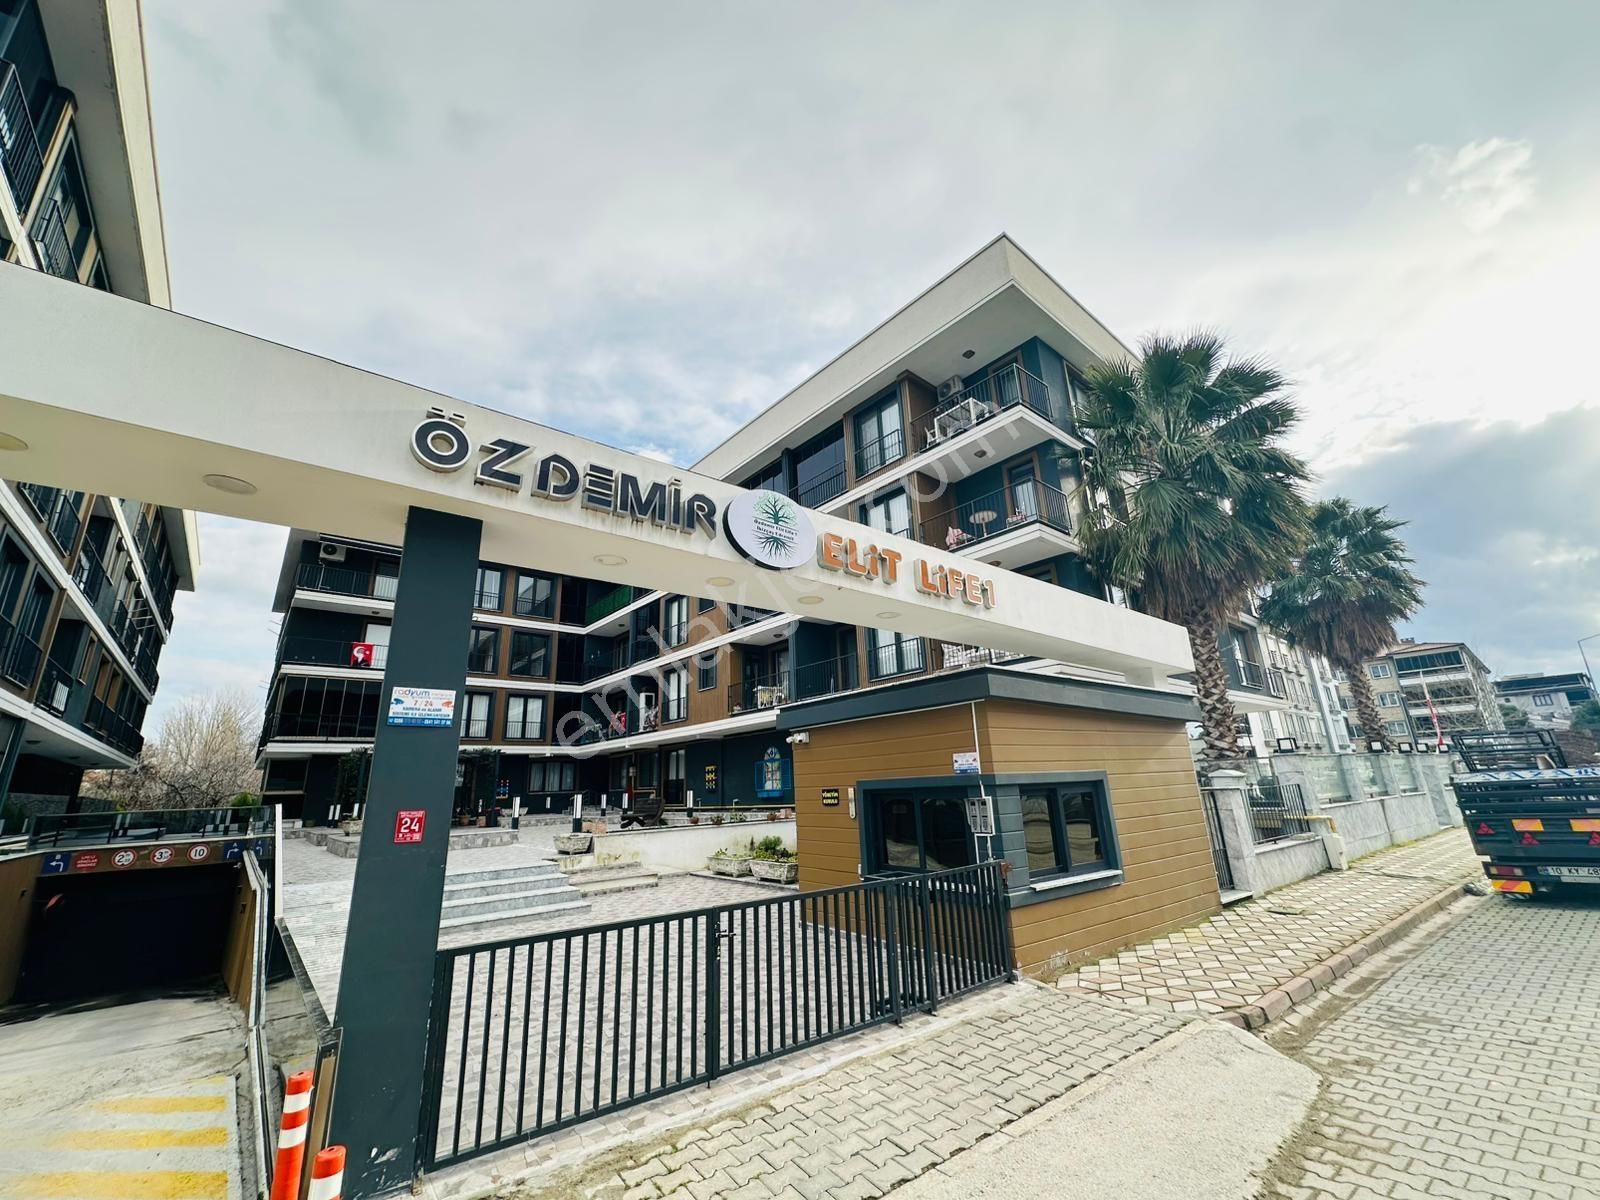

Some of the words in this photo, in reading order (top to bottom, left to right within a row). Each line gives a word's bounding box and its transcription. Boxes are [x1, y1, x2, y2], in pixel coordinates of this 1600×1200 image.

[409, 406, 717, 540] ÖZDEMİR
[400, 817, 420, 833] 24
[193, 846, 205, 857] 10
